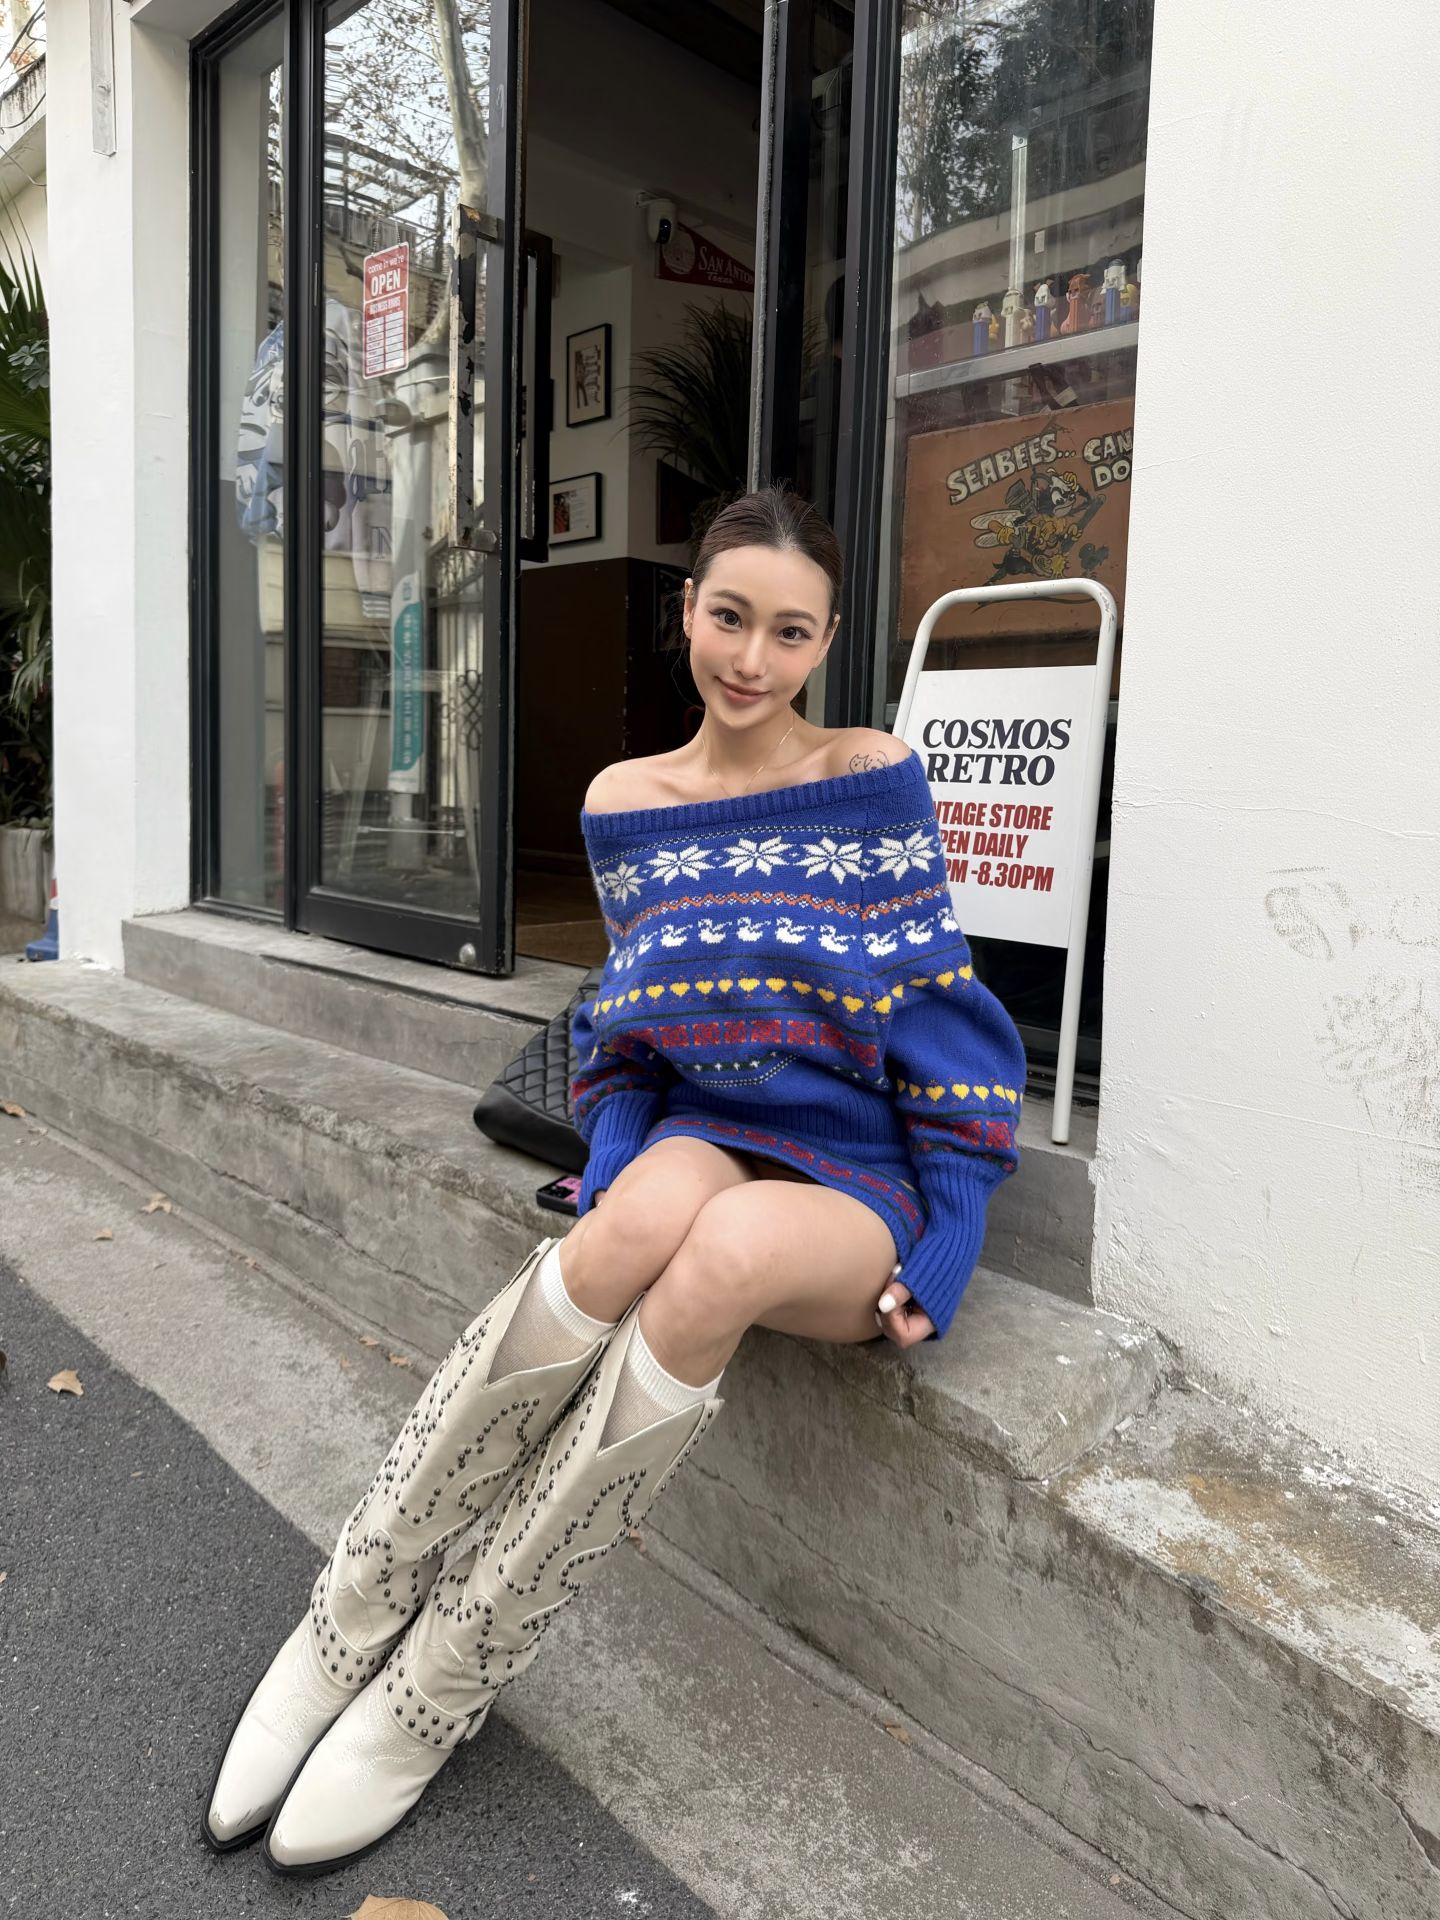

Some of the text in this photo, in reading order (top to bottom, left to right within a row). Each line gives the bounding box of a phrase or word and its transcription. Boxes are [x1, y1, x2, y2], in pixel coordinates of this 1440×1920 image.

[699, 246, 723, 273] SAN
[371, 267, 401, 297] OPEN
[1082, 427, 1133, 465] CAN
[1091, 457, 1132, 491] DO
[922, 718, 1073, 751] COSMOS
[926, 753, 1056, 787] RETRO
[989, 803, 1054, 831] STORE
[940, 829, 1030, 859] PEN DAILY
[945, 858, 1055, 892] PM -8.30PM
